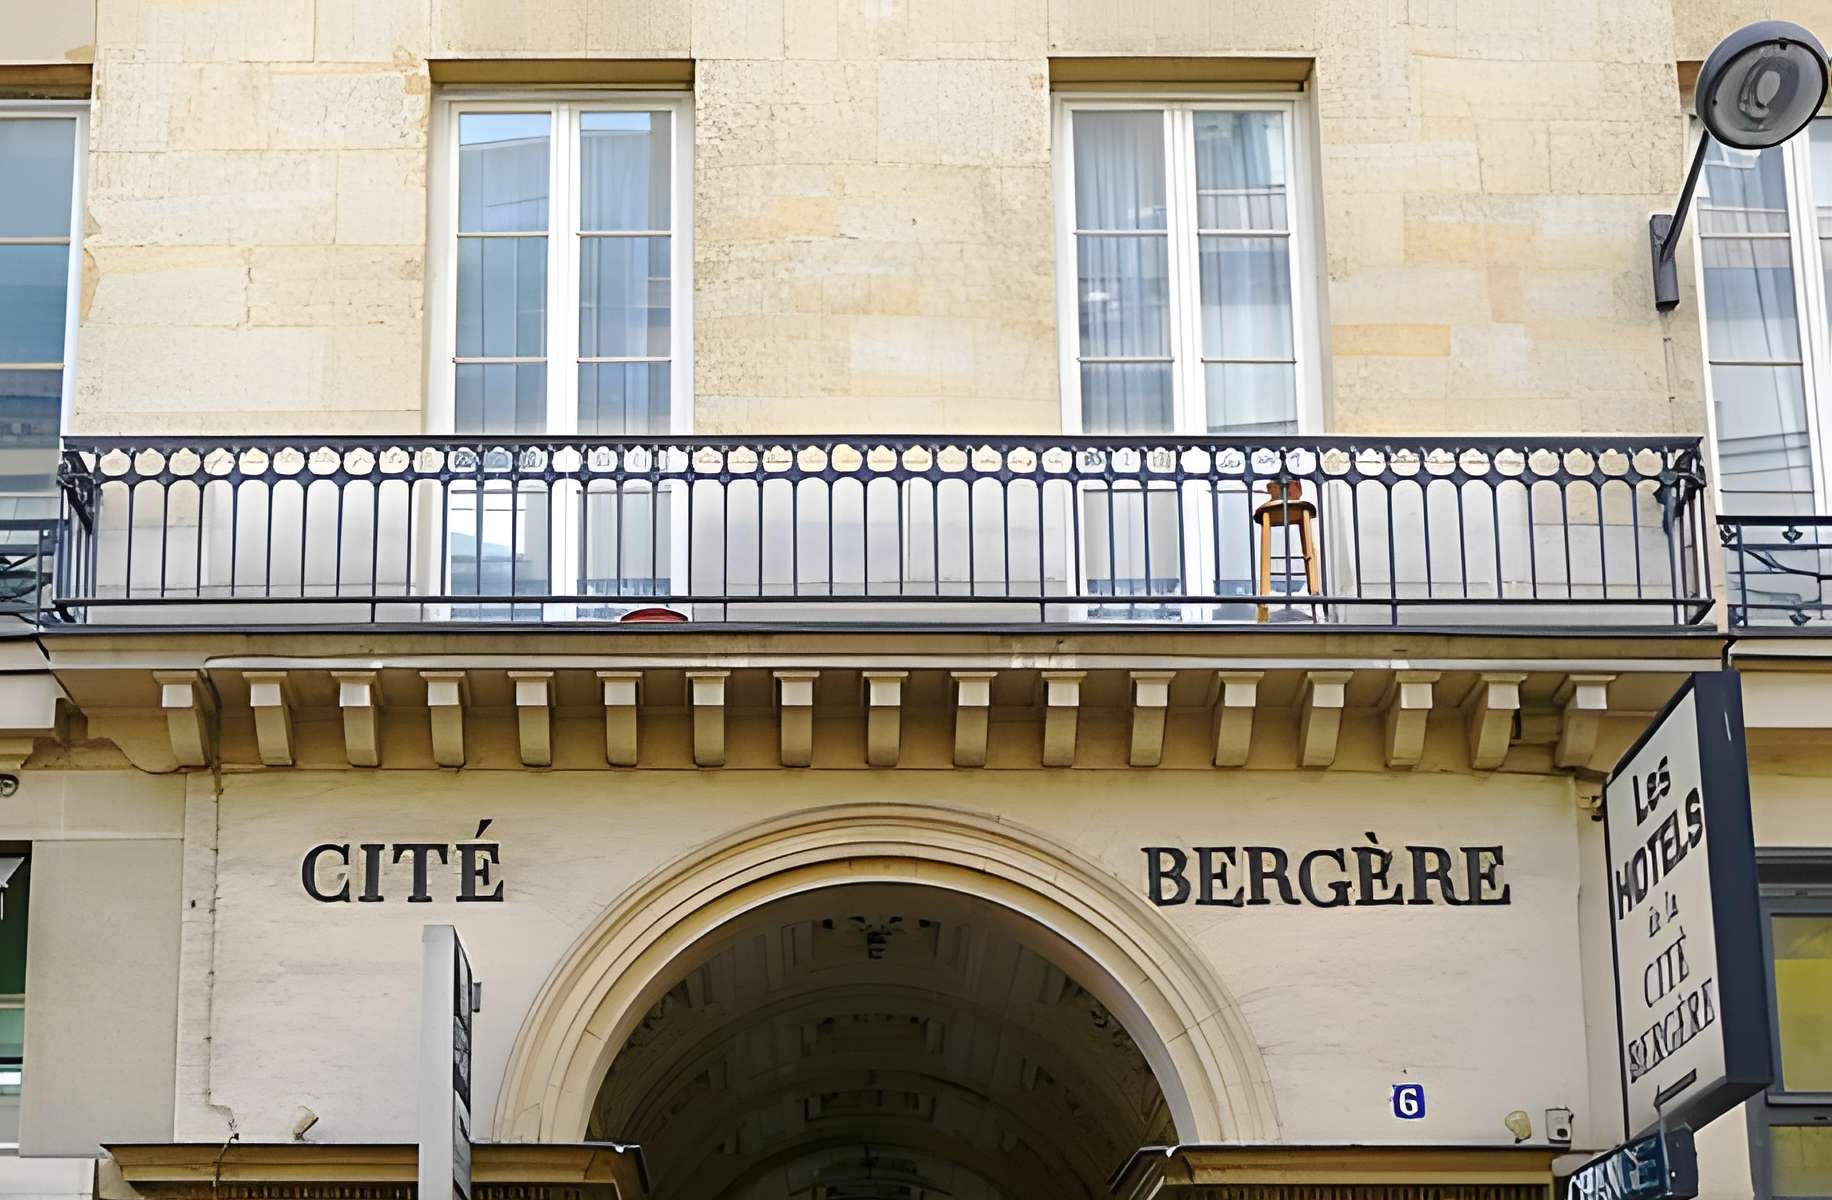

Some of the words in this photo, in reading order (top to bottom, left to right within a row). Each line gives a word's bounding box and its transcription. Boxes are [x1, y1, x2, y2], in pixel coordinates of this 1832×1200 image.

[301, 818, 505, 903] CITÉ
[1140, 831, 1511, 908] BERGÈRE
[1615, 787, 1703, 919] HOTELS
[1399, 1087, 1419, 1116] 6
